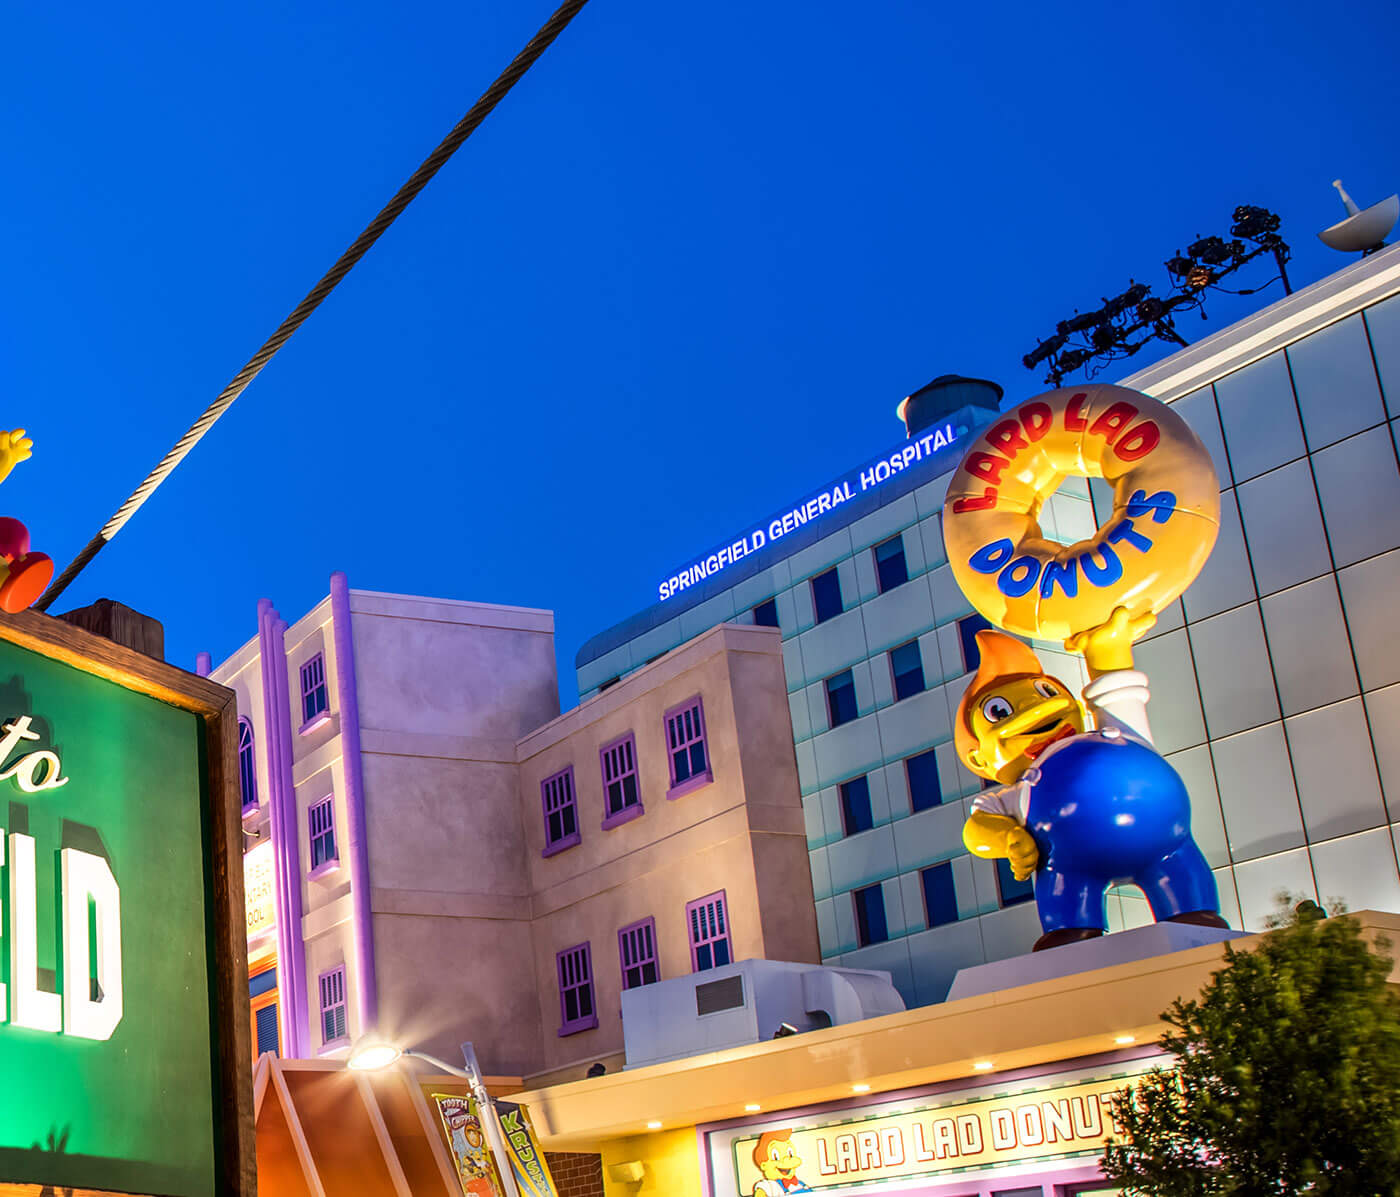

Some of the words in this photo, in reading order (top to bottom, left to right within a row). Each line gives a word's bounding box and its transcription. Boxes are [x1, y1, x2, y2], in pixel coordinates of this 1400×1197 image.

[953, 402, 1053, 514] LARD
[1064, 393, 1160, 462] LAD
[658, 529, 766, 601] SPRINGFIELD
[768, 481, 857, 541] GENERAL
[859, 423, 958, 491] HOSPITAL
[969, 489, 1177, 599] DONUTS
[816, 1127, 905, 1176] LARD
[912, 1113, 984, 1162] LAD
[989, 1089, 1132, 1152] DONUT
